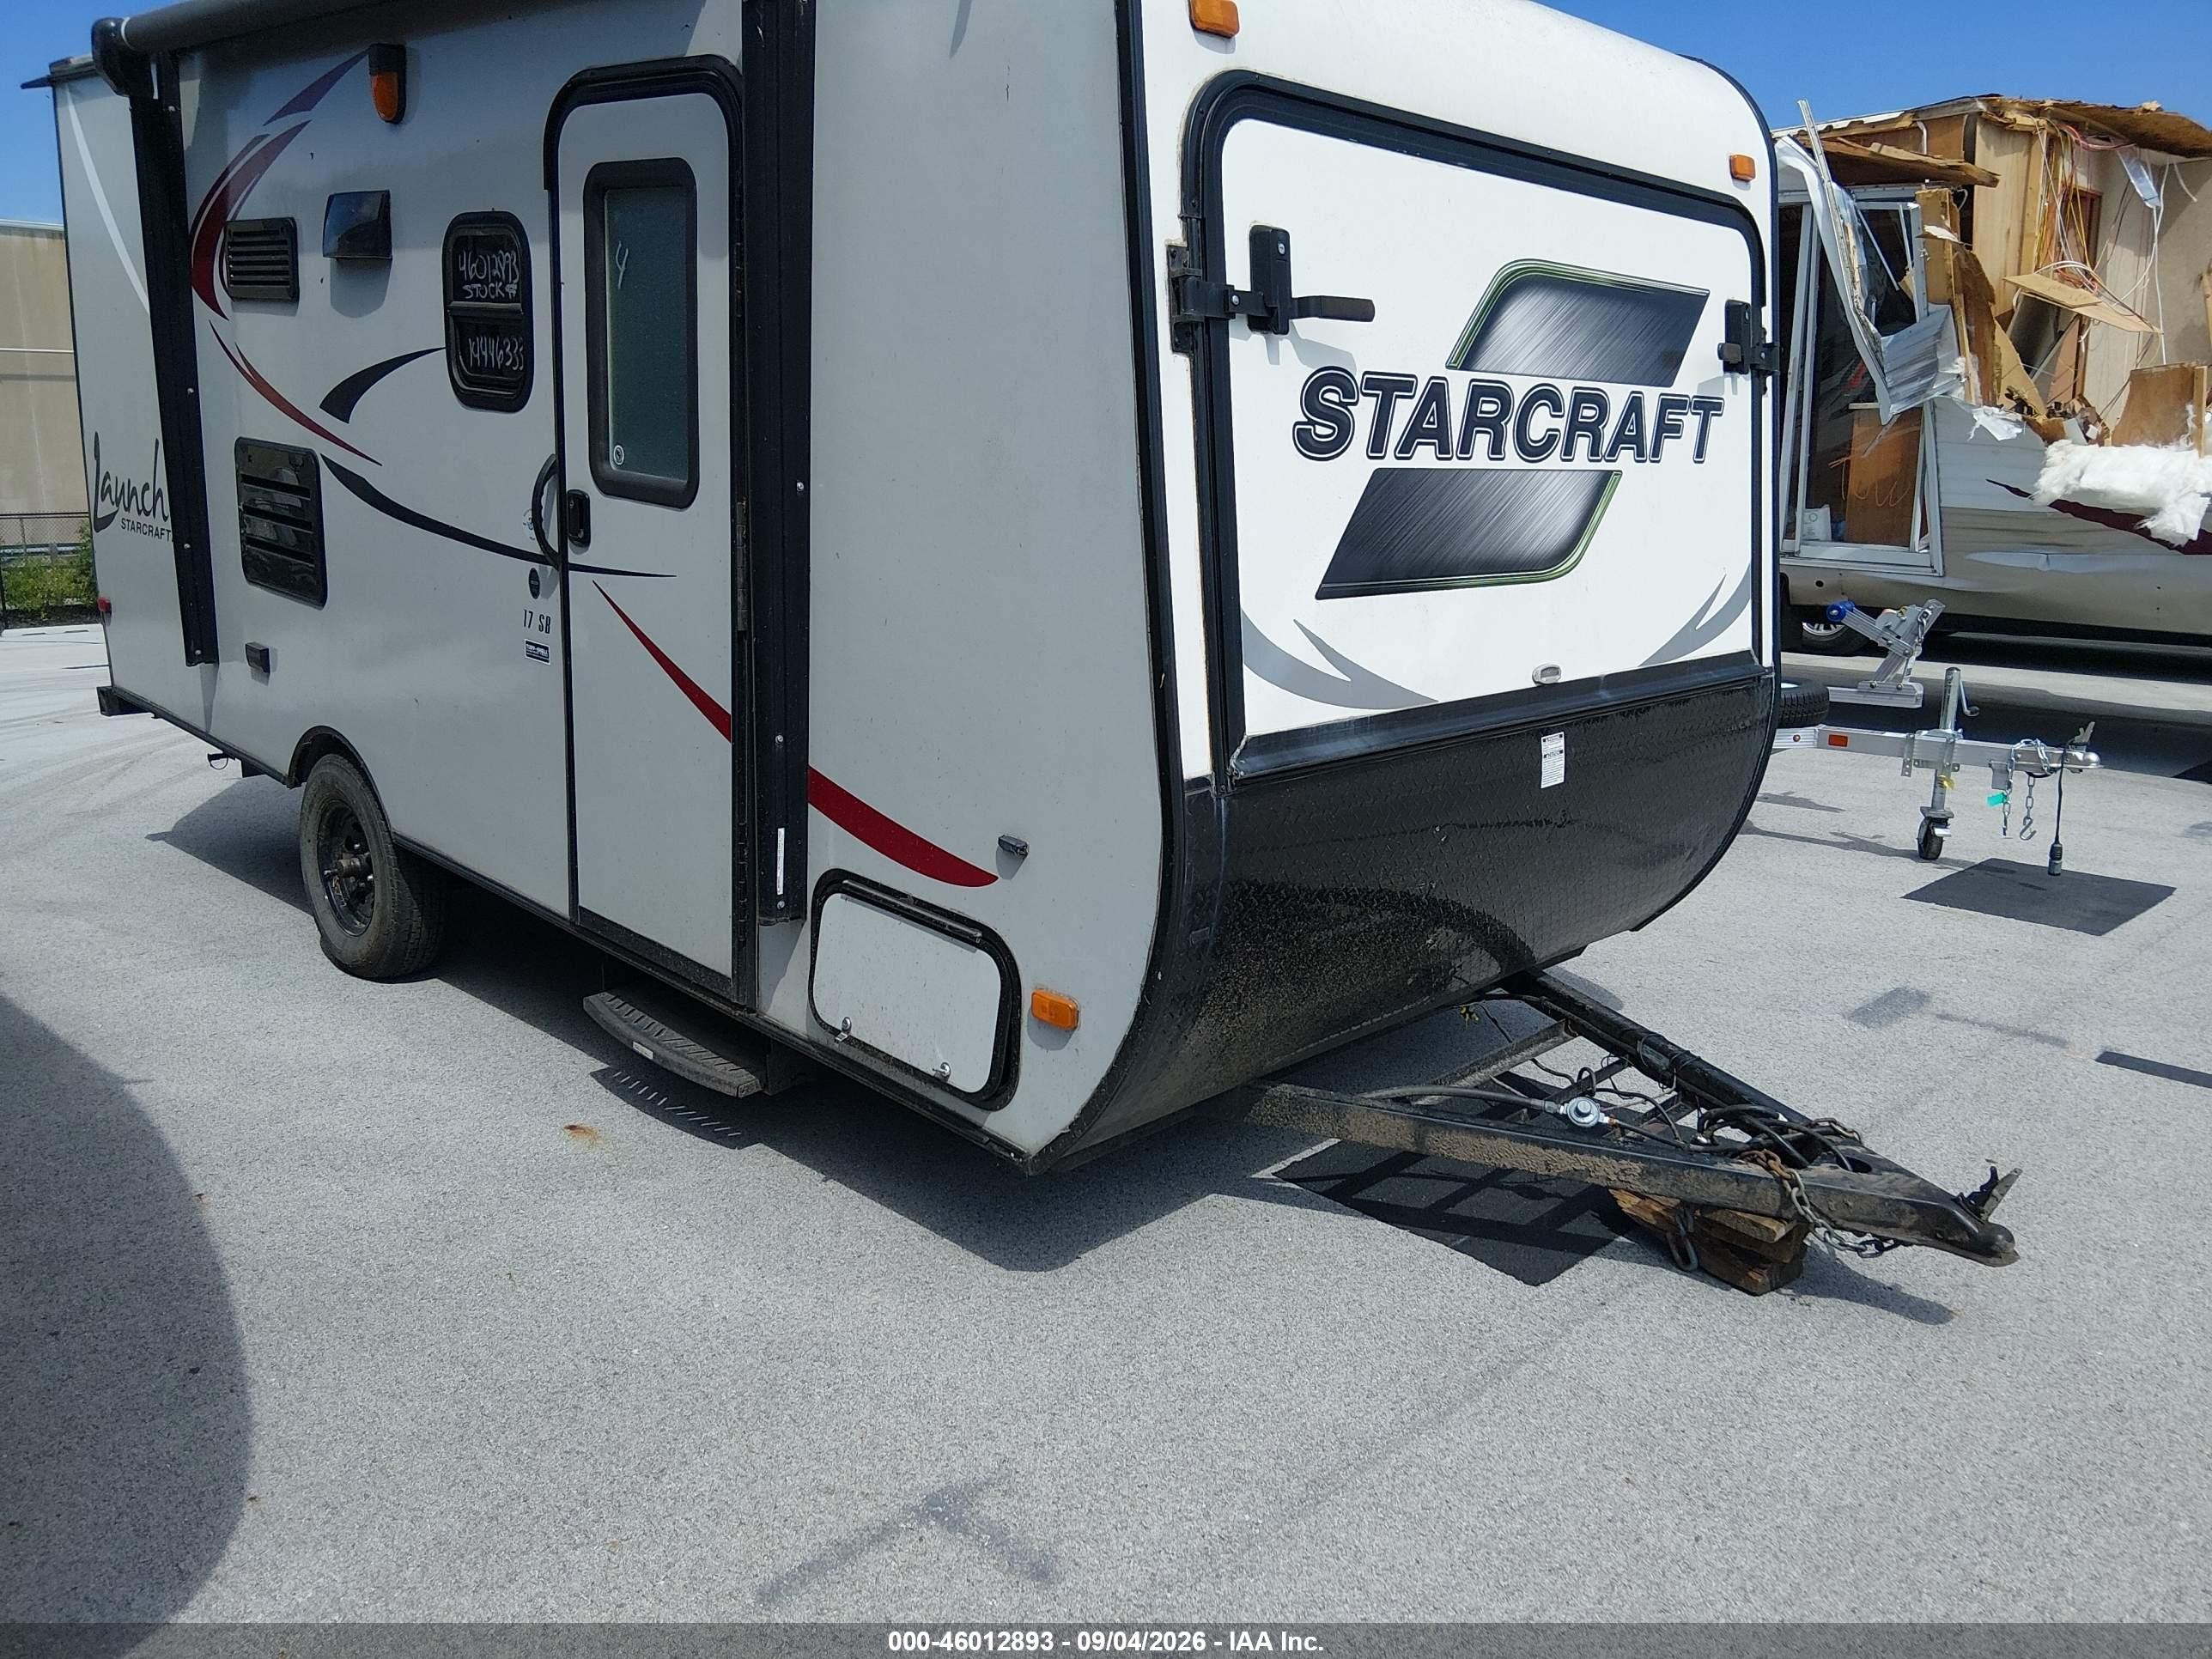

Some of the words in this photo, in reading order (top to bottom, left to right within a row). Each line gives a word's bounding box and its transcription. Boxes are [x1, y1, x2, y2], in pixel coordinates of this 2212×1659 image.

[1292, 366, 1724, 464] STARCRAFT
[94, 431, 169, 533] Launch
[120, 518, 172, 543] STARCRAFT
[523, 609, 533, 629] 17
[538, 614, 551, 634] SB
